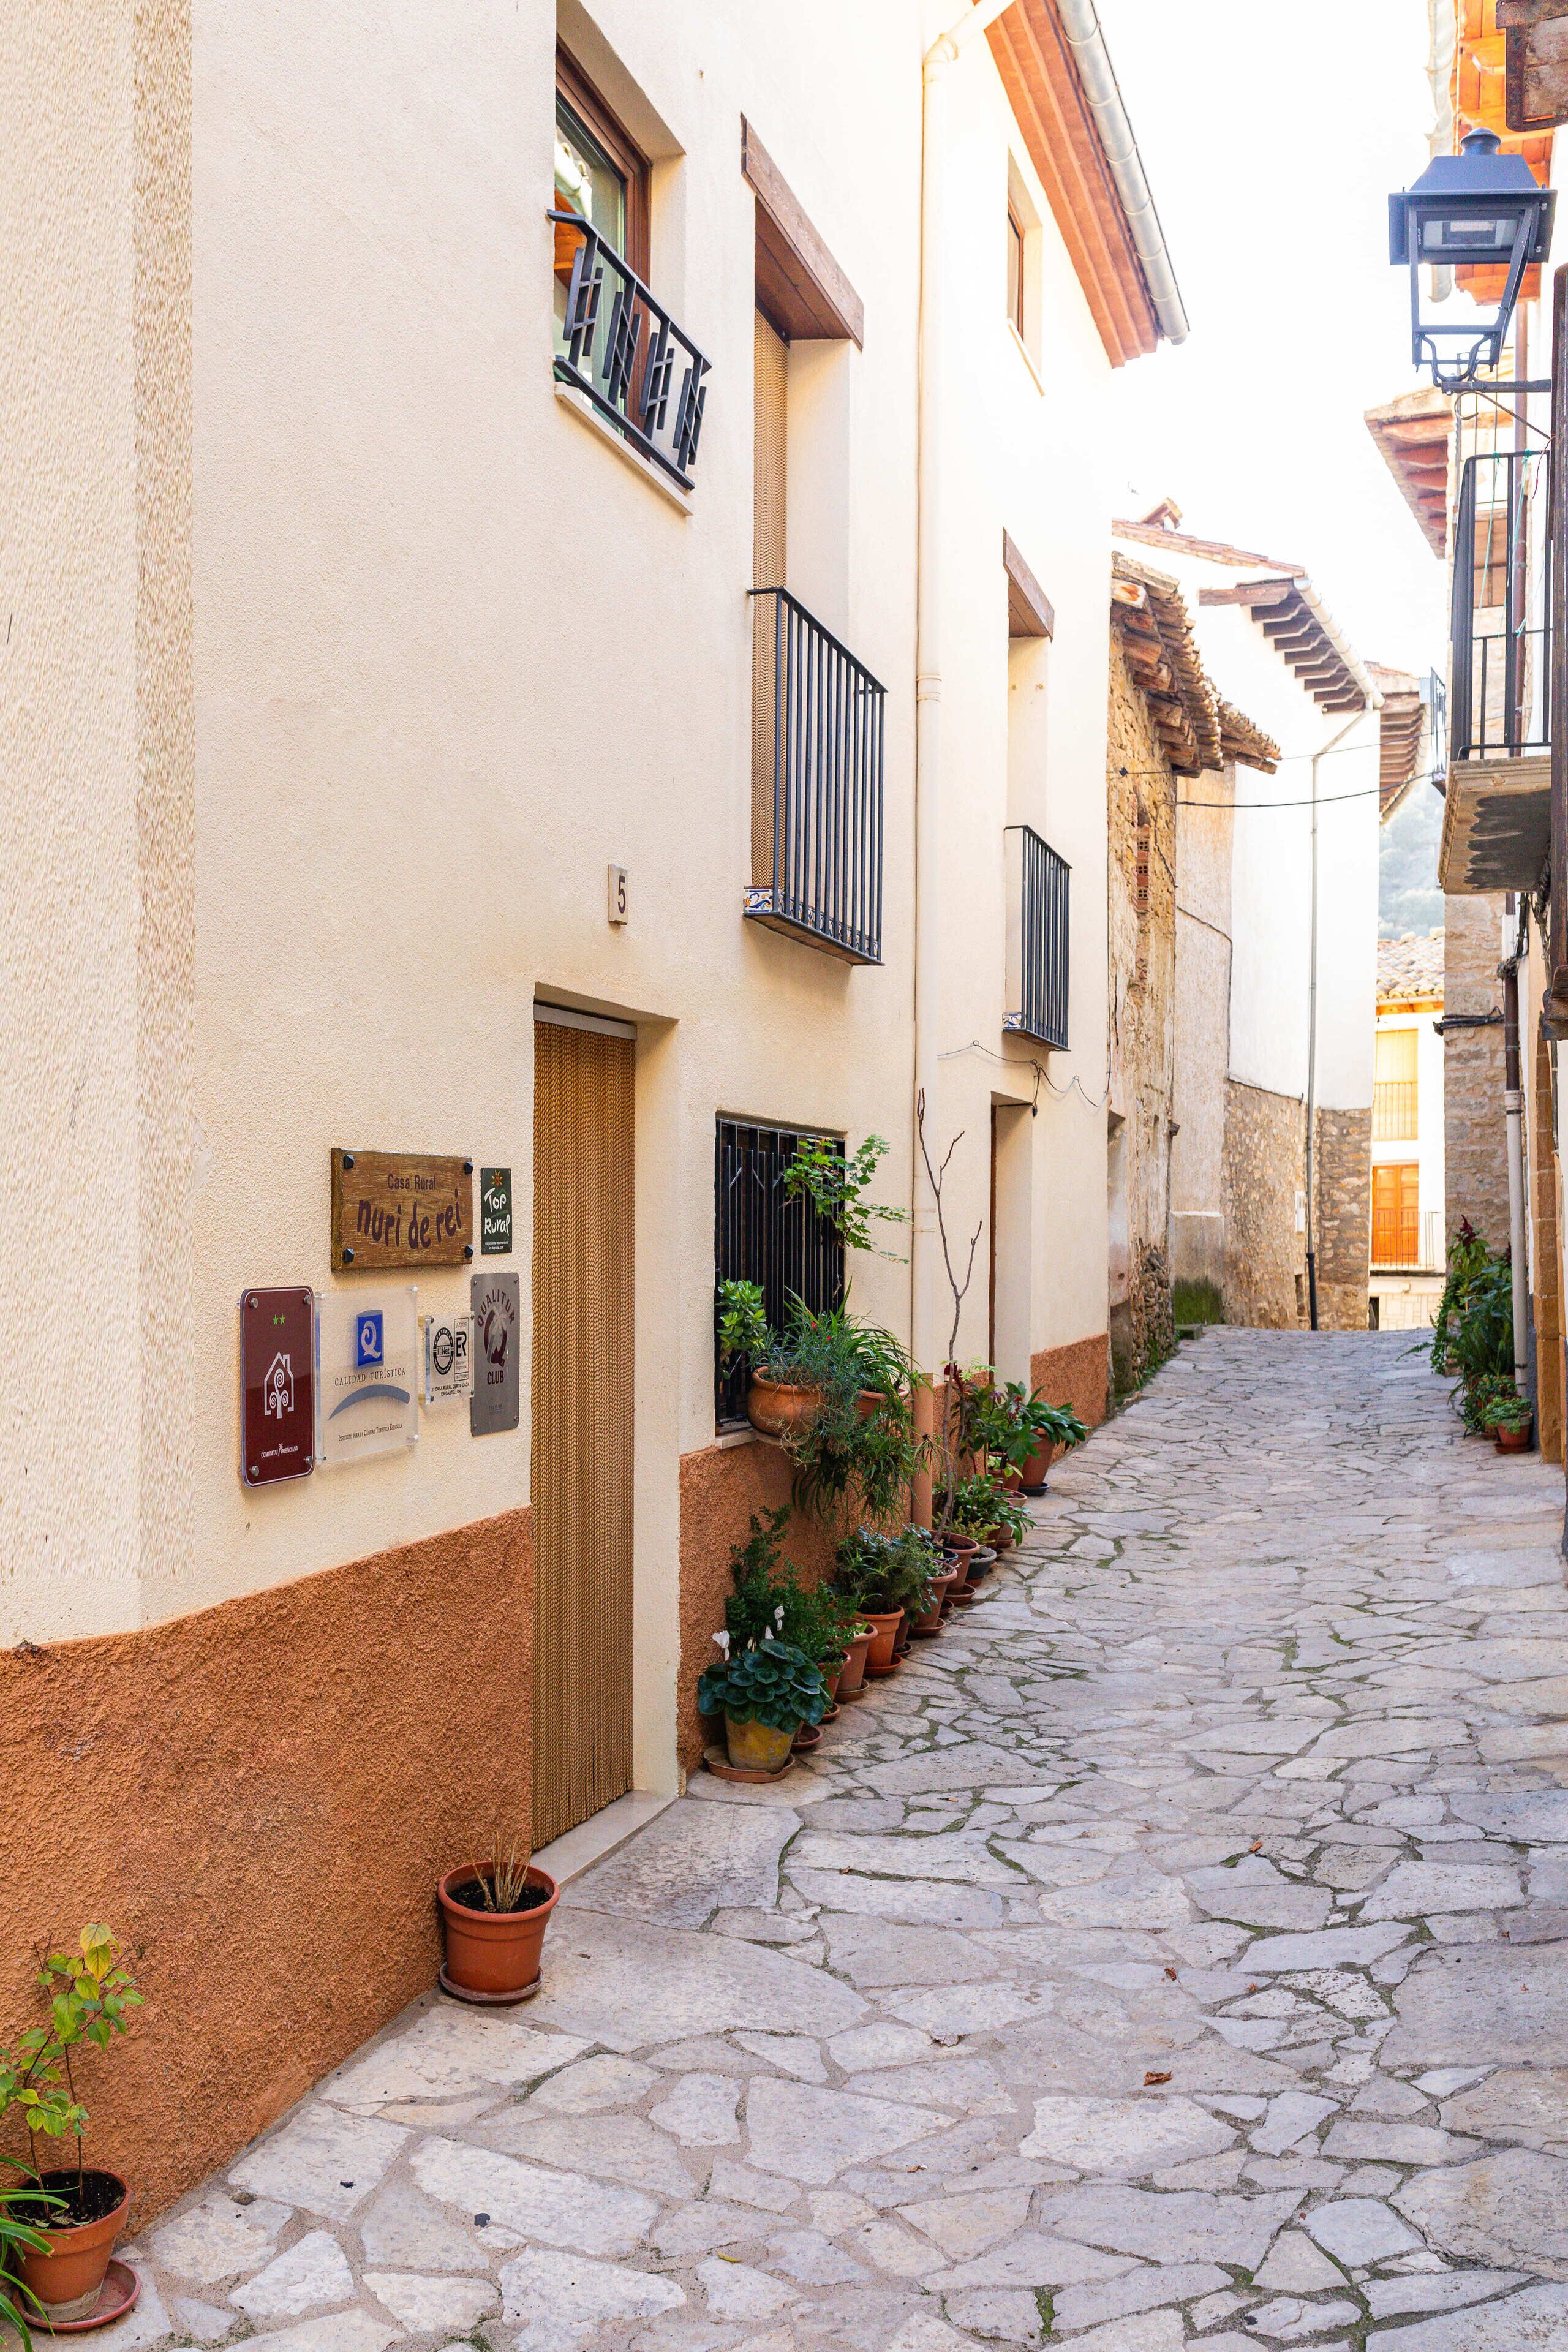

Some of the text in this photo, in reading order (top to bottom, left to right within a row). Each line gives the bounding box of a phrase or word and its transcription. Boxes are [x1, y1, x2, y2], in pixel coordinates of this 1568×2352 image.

[618, 875, 625, 914] 5
[388, 1173, 436, 1190] Casa Rural
[484, 1187, 507, 1212] Top
[357, 1188, 461, 1250] nuri de rei
[484, 1214, 510, 1236] Rural
[477, 1289, 514, 1327] QUALITUR
[334, 1368, 405, 1386] CALIDAD TURÍSTICA
[487, 1370, 504, 1385] CLUB
